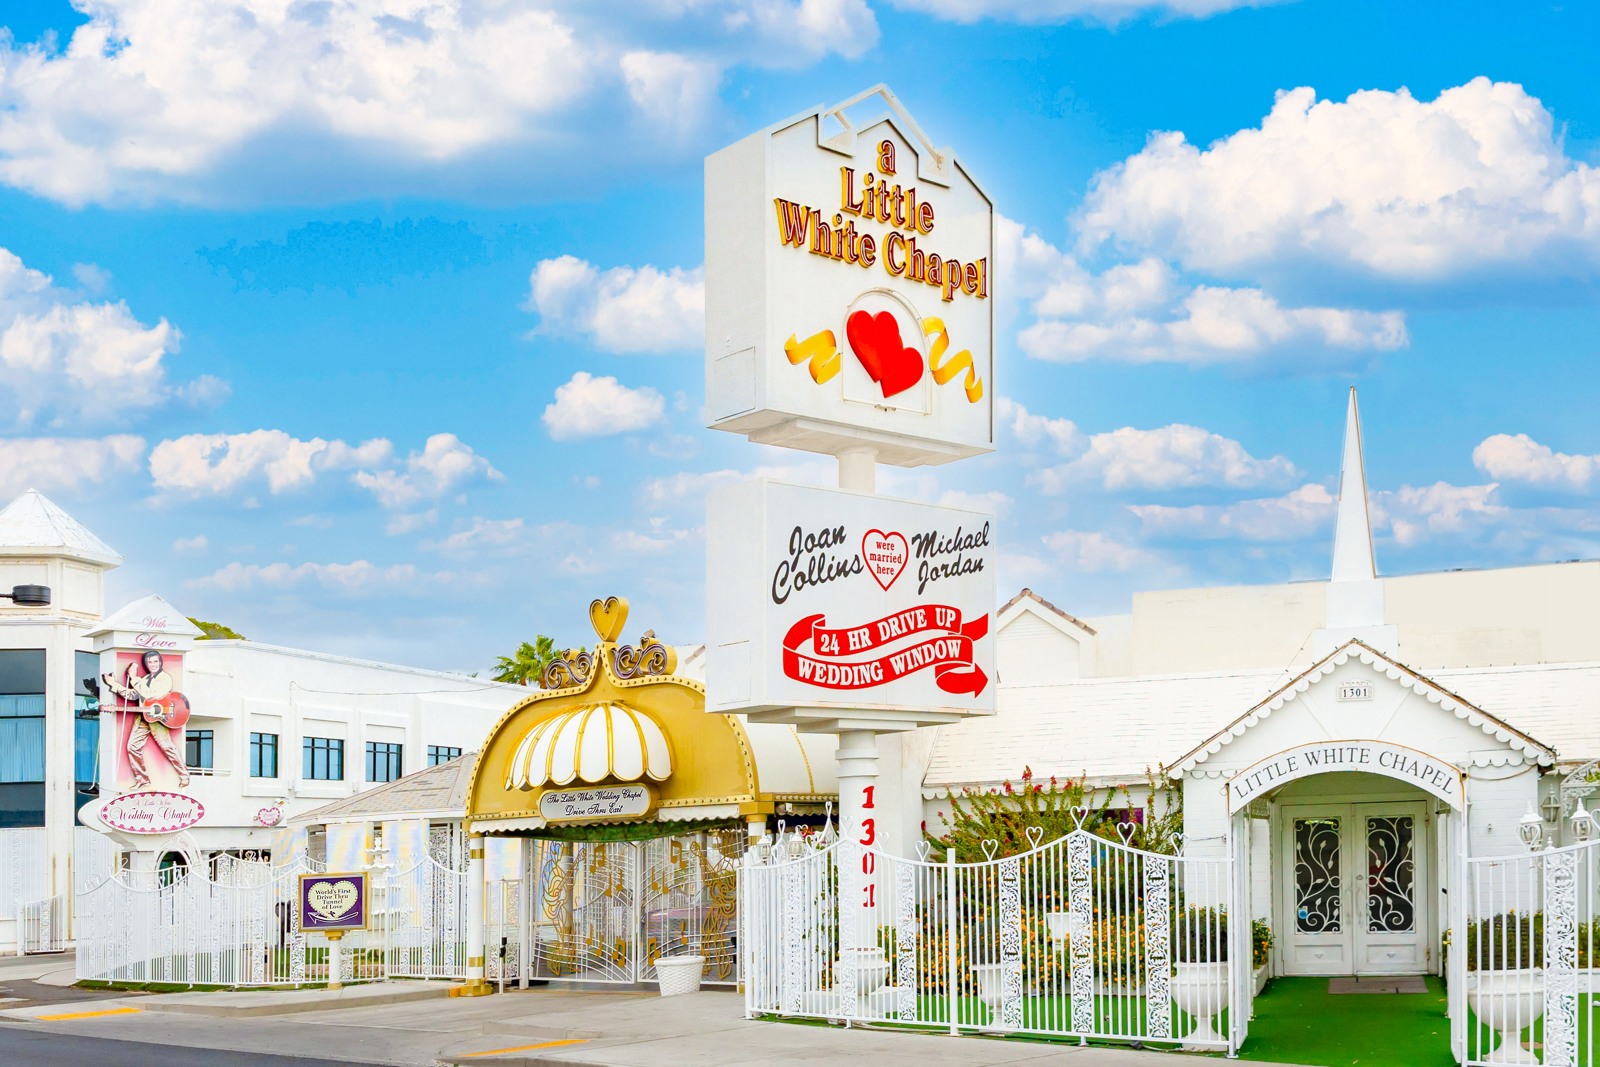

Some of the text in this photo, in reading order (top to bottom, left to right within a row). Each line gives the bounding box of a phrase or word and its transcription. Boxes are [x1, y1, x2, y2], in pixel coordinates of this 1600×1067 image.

[877, 139, 897, 175] a
[840, 166, 935, 235] Little
[773, 197, 988, 302] White Chapel
[789, 525, 847, 572] Joan
[876, 541, 895, 551] were
[911, 521, 990, 558] Michael
[869, 552, 902, 564] married
[876, 564, 895, 576] here
[917, 552, 984, 595] Jordan
[772, 552, 864, 605] Collins
[141, 615, 168, 629] With
[820, 607, 957, 655] 24 HR DRIVE UP
[132, 632, 177, 649] Love
[797, 639, 962, 687] WEDDING WINDOW
[1343, 687, 1367, 698] 1301
[1234, 747, 1453, 799] LITTLE WHITE CHAPEL
[565, 804, 586, 816] Drive
[587, 803, 607, 815] Thru
[577, 791, 594, 801] White
[595, 790, 620, 802] Wedding
[621, 788, 644, 801] Chapel
[110, 806, 193, 823] Wedding Chapel
[859, 785, 876, 908] 1301
